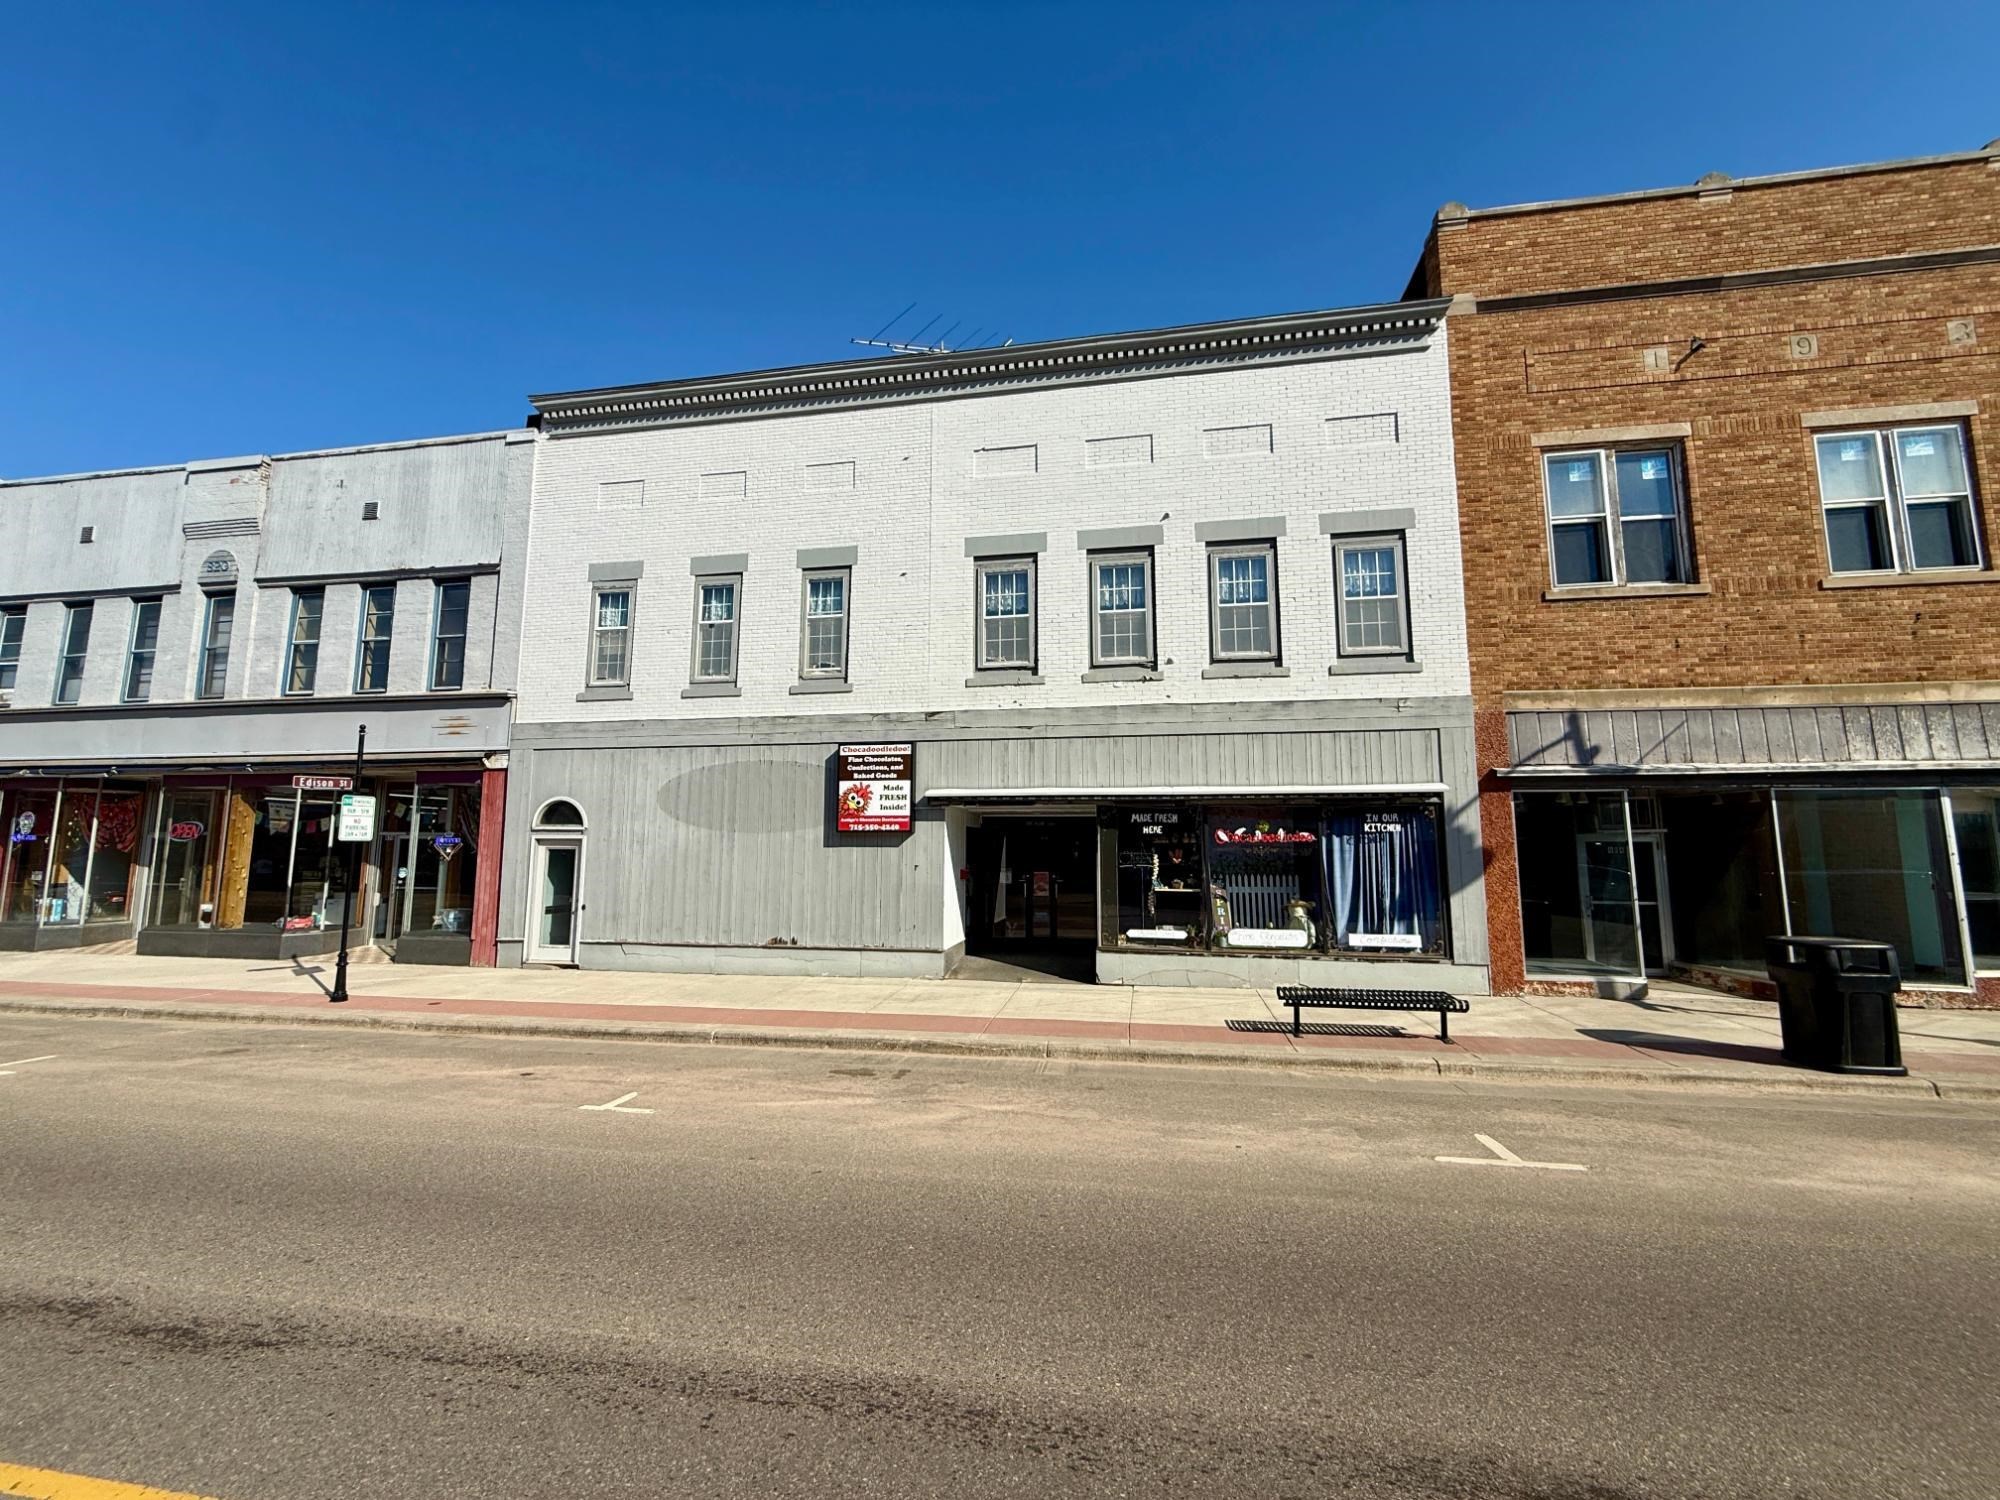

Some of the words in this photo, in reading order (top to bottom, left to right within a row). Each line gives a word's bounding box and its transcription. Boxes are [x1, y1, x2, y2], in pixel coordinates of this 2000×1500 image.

[1797, 337, 1811, 355] 9
[842, 745, 910, 753] Chocadoodledoo!
[299, 777, 334, 787] Edison
[339, 779, 348, 787] St
[1131, 813, 1152, 823] MADE
[1154, 813, 1178, 823] FRESH
[1365, 813, 1378, 822] IN
[1382, 813, 1399, 822] OUR
[170, 823, 199, 839] OPEN
[1142, 825, 1163, 834] HERE
[1364, 823, 1401, 832] KITCHEN
